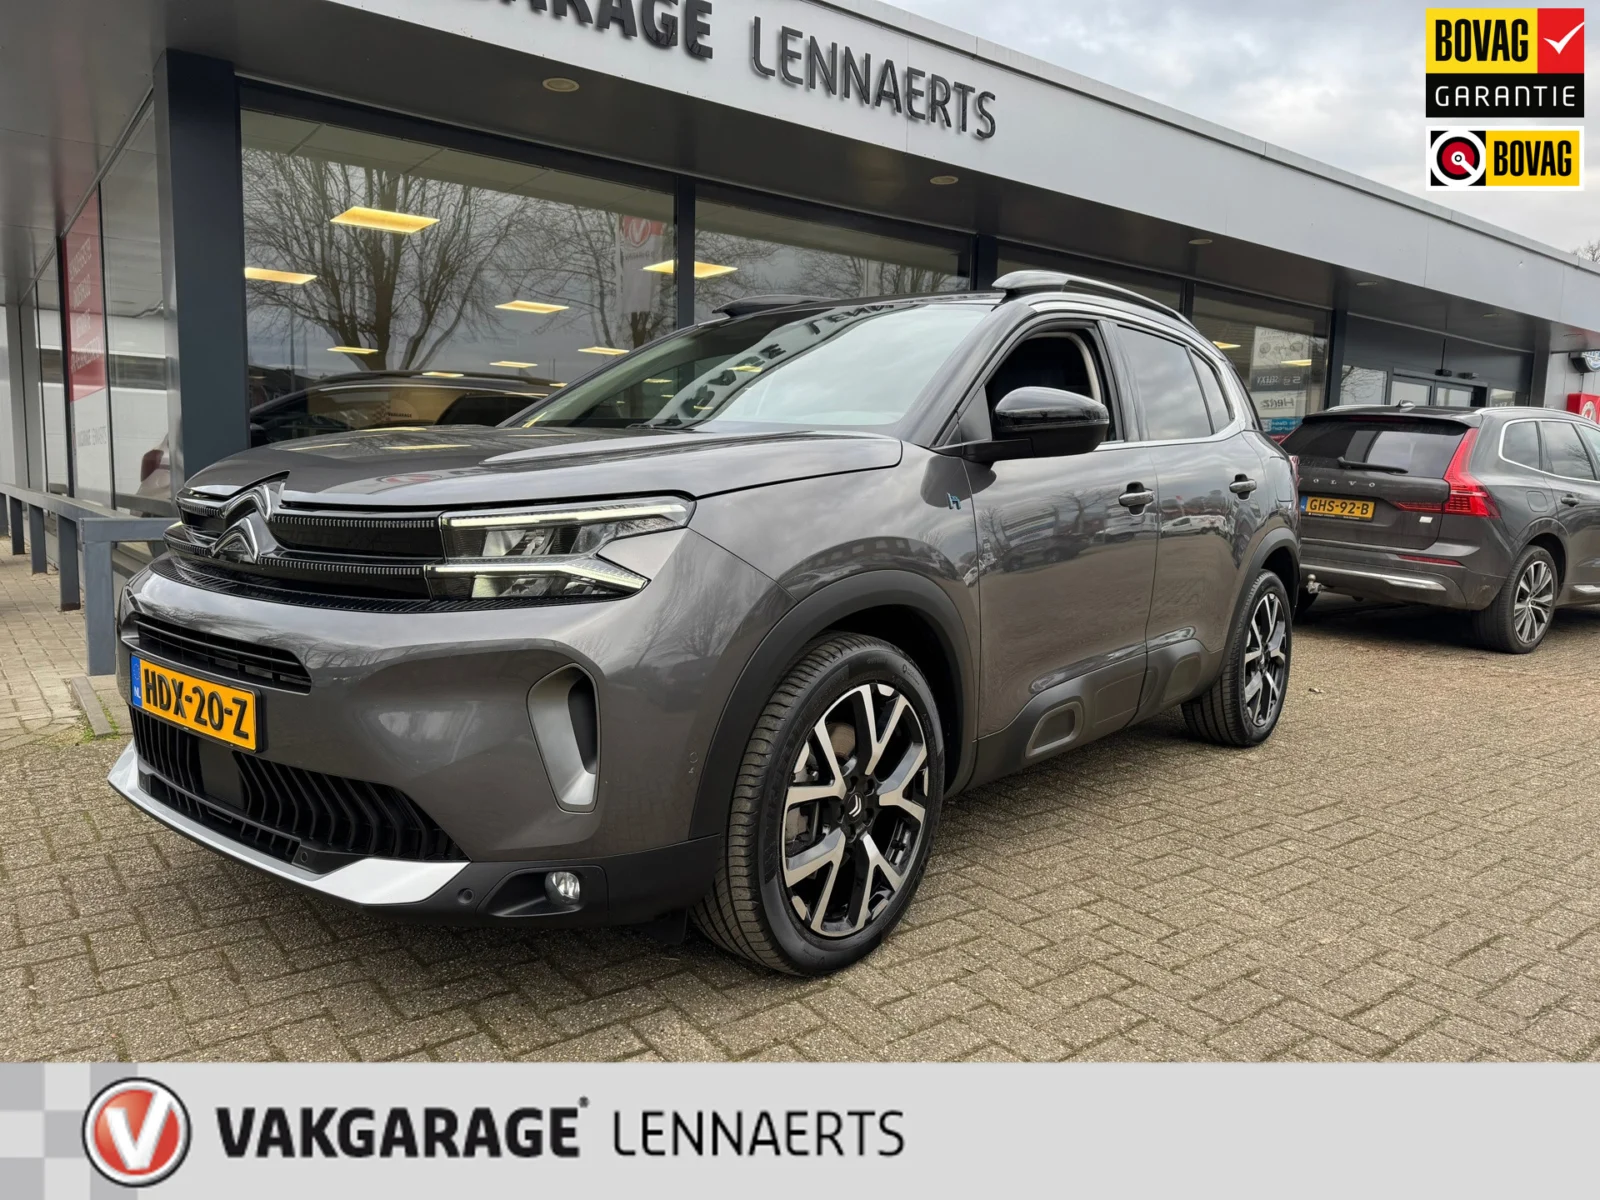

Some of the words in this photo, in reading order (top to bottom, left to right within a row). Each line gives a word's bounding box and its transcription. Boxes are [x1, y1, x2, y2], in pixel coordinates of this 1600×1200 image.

[752, 15, 997, 140] LENNAERTS
[1309, 498, 1370, 516] GHS-92-B
[133, 686, 141, 699] NL
[144, 668, 249, 740] HDX-20-Z
